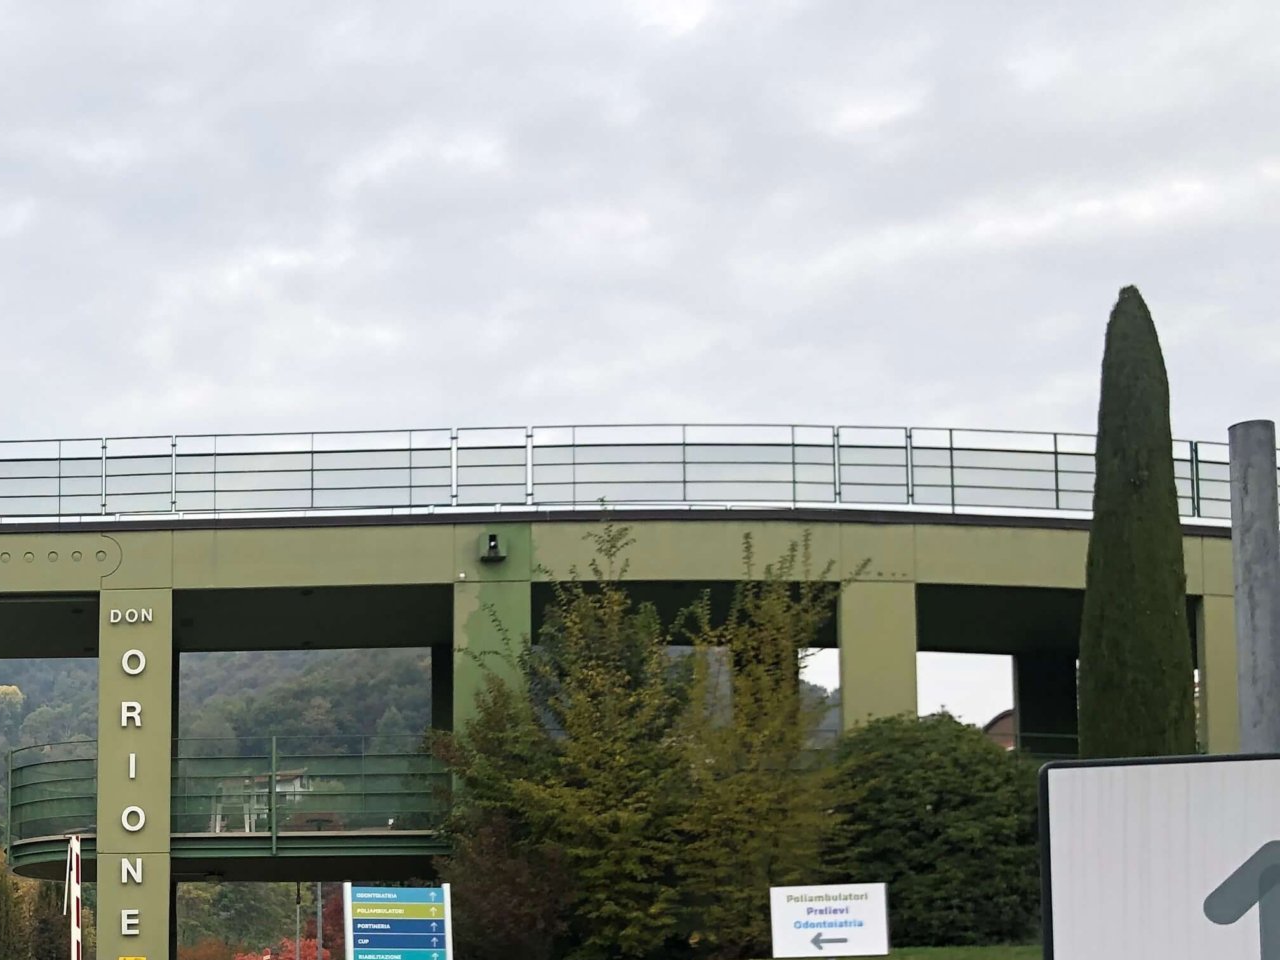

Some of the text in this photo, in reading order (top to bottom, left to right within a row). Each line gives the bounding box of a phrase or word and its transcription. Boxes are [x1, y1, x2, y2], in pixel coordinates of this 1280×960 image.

[109, 608, 153, 624] DON
[120, 648, 147, 936] ORIONE
[786, 892, 868, 903] Poliambulatori
[806, 906, 849, 916] Prelievi
[793, 919, 864, 929] Odontoiatria
